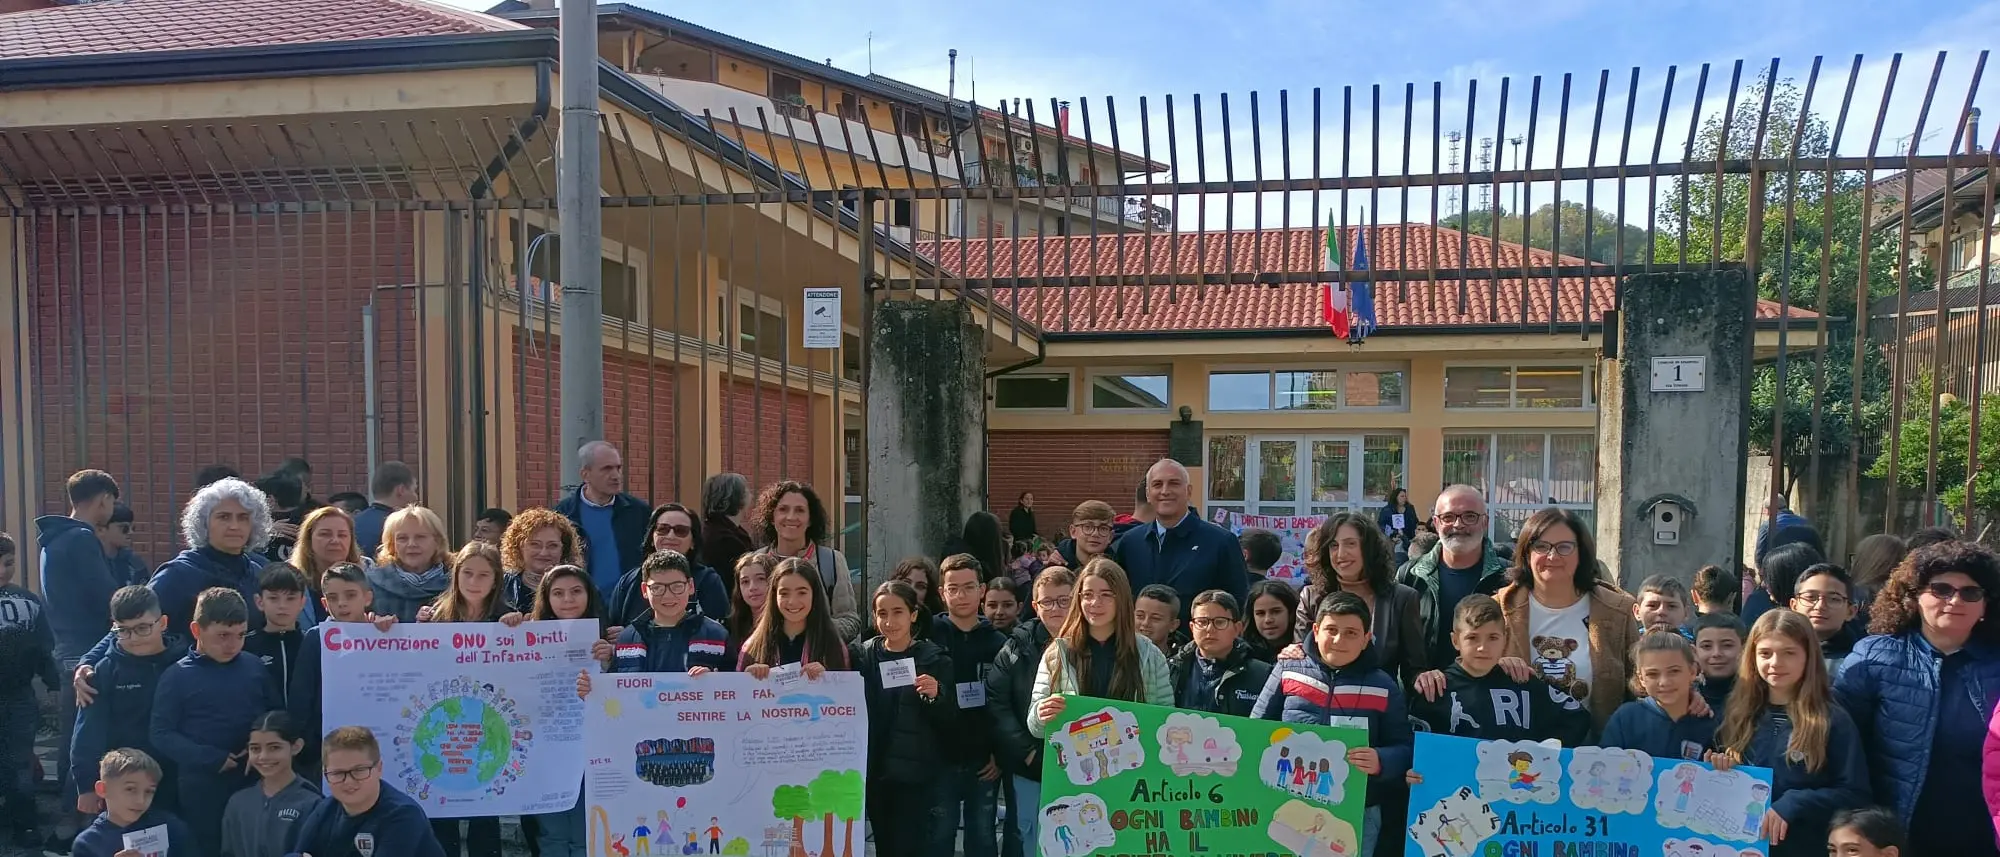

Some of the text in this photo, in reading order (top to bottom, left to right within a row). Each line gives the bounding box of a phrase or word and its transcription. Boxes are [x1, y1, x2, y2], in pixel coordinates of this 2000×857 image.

[1674, 365, 1682, 381] 1
[1241, 515, 1269, 528] DIRITTI
[1274, 517, 1287, 529] DEI
[324, 627, 568, 651] Convenzione ONU sui Diritti
[616, 678, 652, 688] FUORI
[658, 691, 704, 702] CLASSE
[714, 690, 736, 700] PER
[677, 706, 856, 721] SENTIRE LA NOSTRA VOCE!
[1129, 778, 1224, 804] Articolo 6
[1110, 808, 1259, 830] OGNI BAMBINO
[1500, 810, 1609, 837] Articolo 31
[1145, 831, 1208, 853] HA IL
[1484, 840, 1640, 857] OGNI BAMBINO
